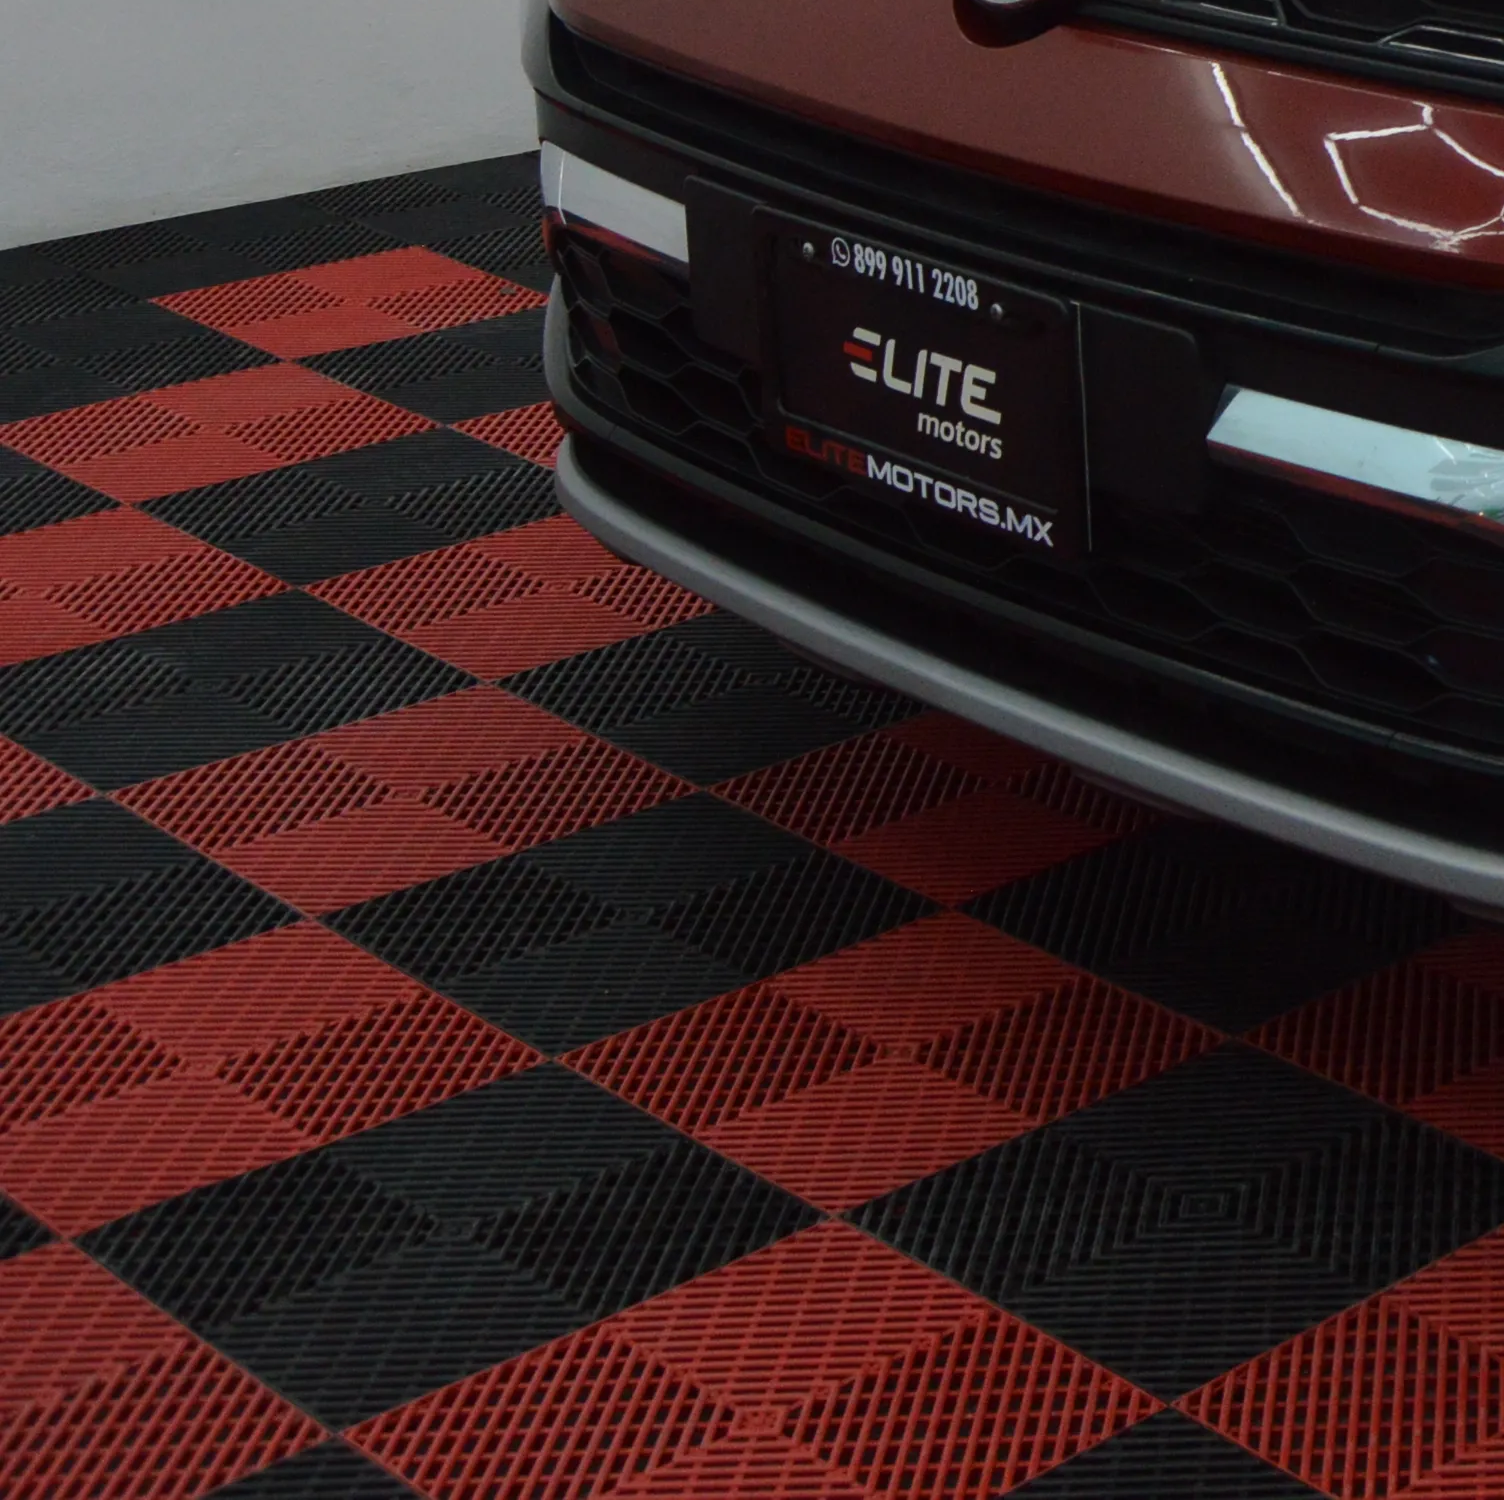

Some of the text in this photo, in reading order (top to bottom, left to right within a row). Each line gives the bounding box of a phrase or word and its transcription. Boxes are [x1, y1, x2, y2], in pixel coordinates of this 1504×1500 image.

[853, 242, 980, 311] 899 911 2208
[843, 327, 1002, 426] ELITE
[917, 411, 1003, 460] motors
[785, 425, 1054, 547] ELITEMOTORS.MX
